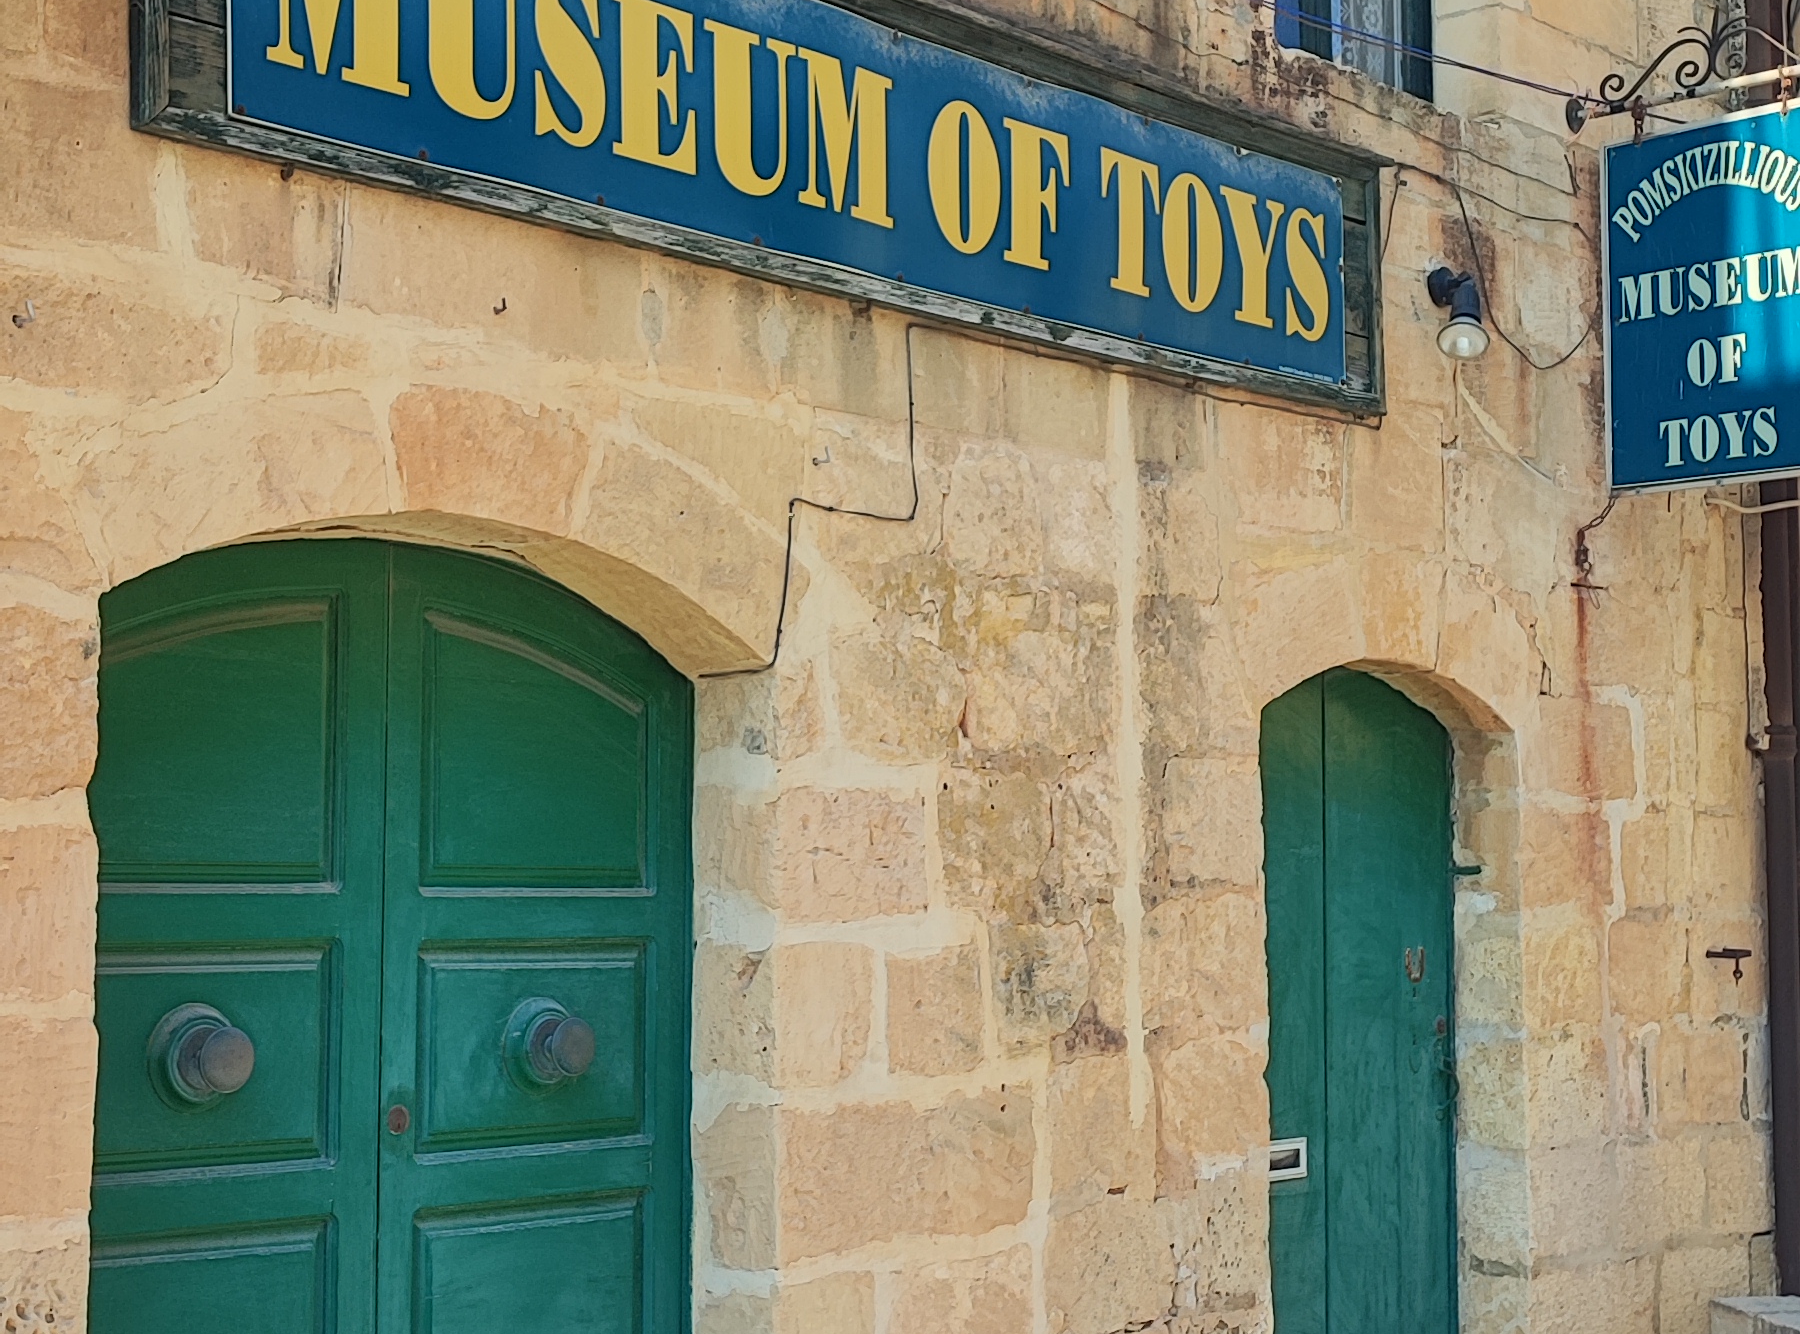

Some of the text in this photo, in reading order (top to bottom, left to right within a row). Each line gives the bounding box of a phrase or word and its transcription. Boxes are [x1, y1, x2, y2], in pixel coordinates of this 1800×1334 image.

[928, 100, 1070, 271] OF
[1100, 147, 1329, 341] TOYS
[1619, 246, 1800, 323] MUSEUM
[1687, 333, 1747, 387] OF
[1659, 406, 1778, 467] TOYS
